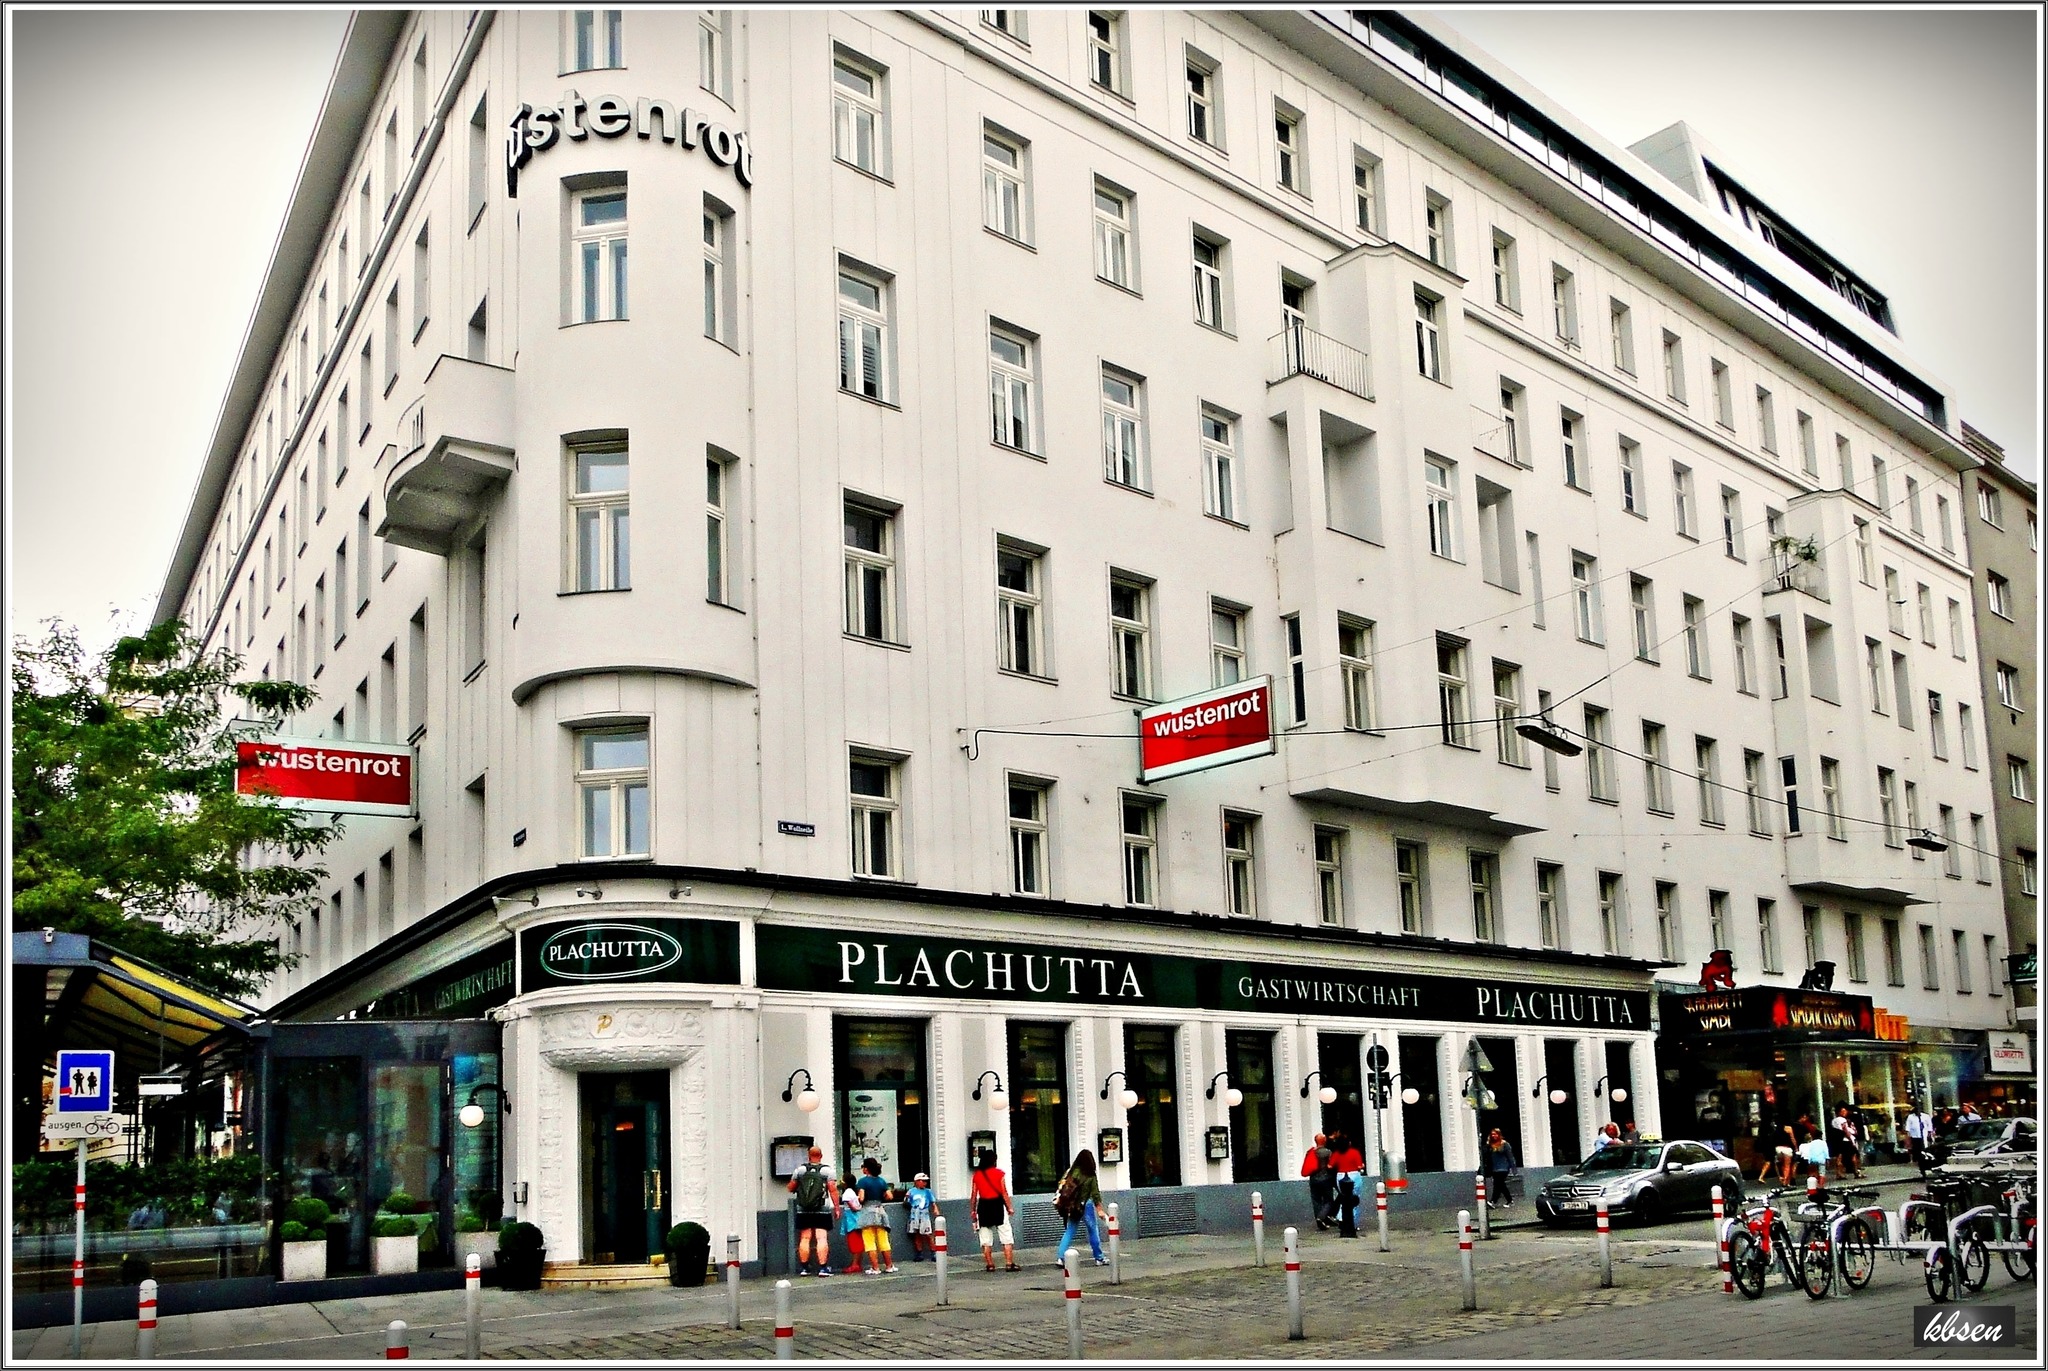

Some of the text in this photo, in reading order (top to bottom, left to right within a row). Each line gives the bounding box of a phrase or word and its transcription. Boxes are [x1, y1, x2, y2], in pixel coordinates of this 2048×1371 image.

[549, 941, 664, 961] PLACHUTTA
[837, 941, 1144, 997] PLACHUTTA
[1238, 976, 1420, 1008] GASTWIRTSCHAFT
[1477, 987, 1633, 1024] PLACHUTTA
[48, 1121, 85, 1131] ausgen.
